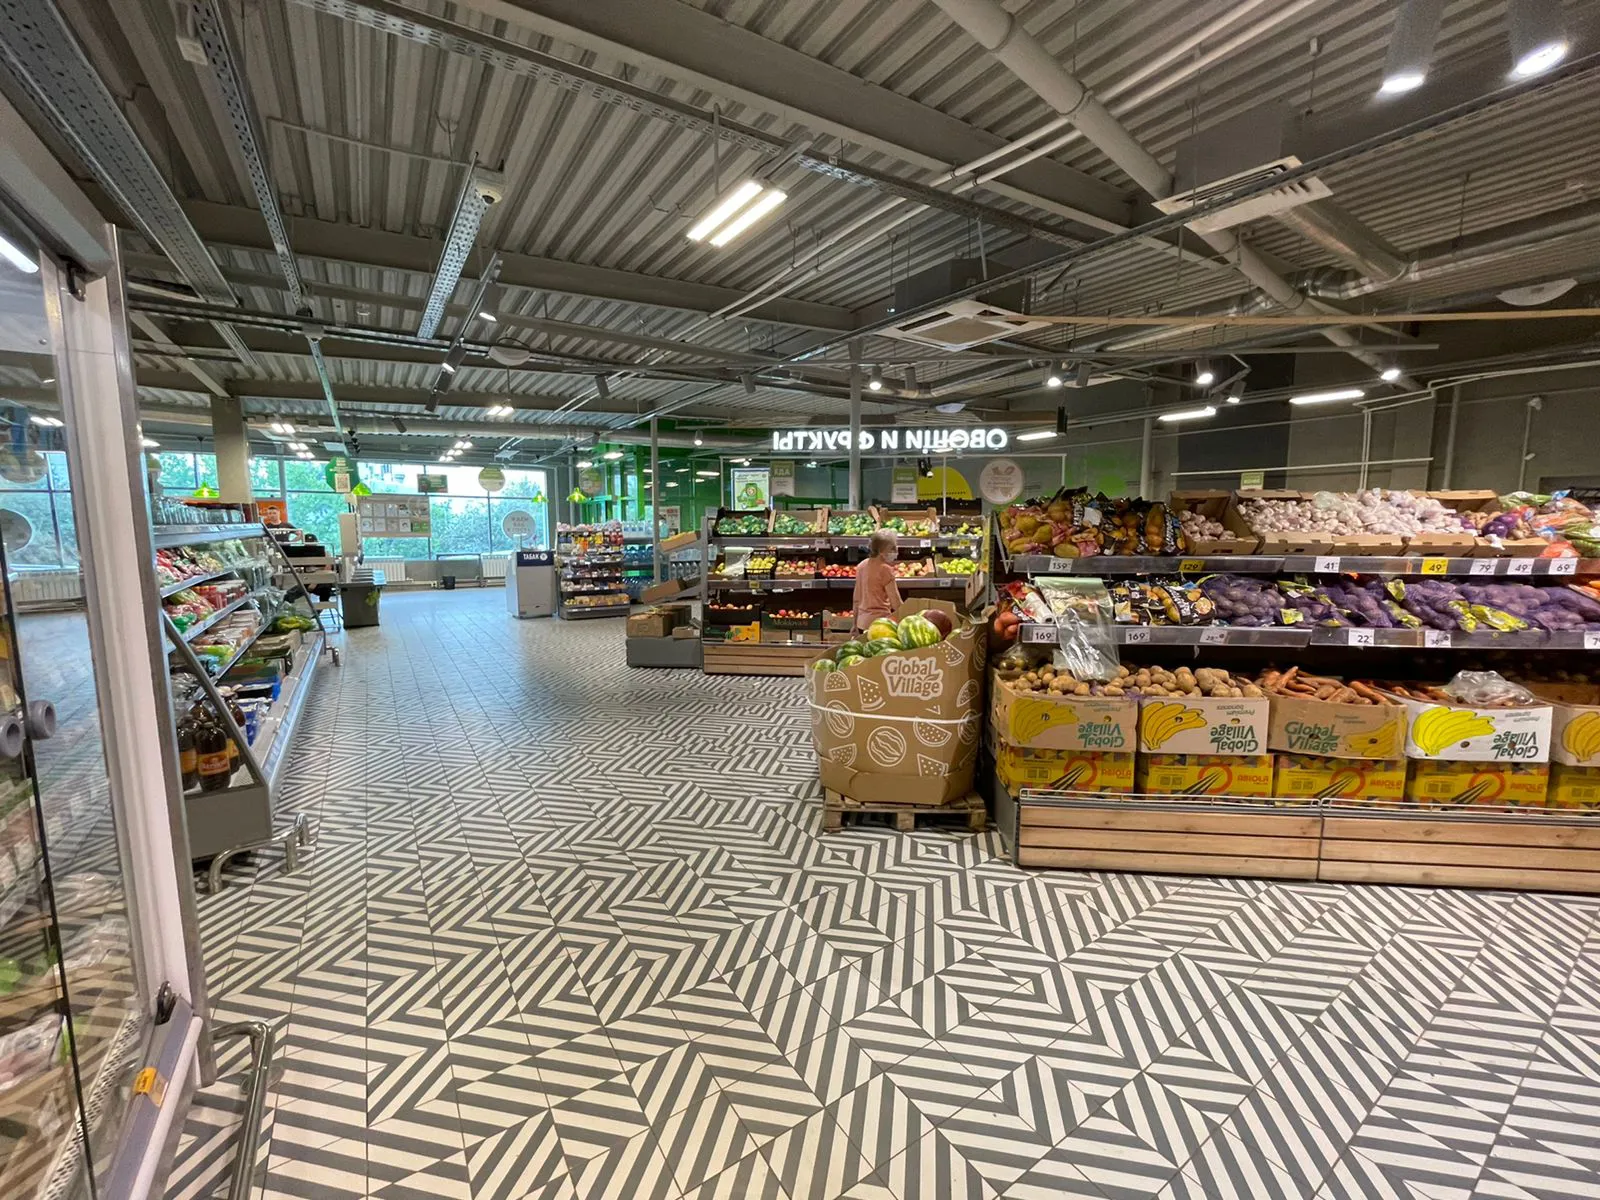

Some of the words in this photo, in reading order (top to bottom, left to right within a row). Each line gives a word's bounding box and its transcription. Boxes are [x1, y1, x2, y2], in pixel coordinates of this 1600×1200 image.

[1052, 562, 1068, 570] 159
[1323, 562, 1335, 570] 41
[1428, 564, 1442, 572] 49
[1479, 564, 1491, 573] 79
[1514, 564, 1528, 572] 49
[1556, 563, 1570, 572] 69
[1035, 632, 1051, 641] 169
[1128, 632, 1145, 641] 169
[1357, 634, 1370, 643] 22
[885, 659, 933, 675] Global
[888, 676, 940, 697] Village
[1078, 722, 1122, 736] Village
[1210, 724, 1255, 739] Village
[1284, 721, 1335, 737] Global
[1085, 733, 1125, 748] Global
[1216, 737, 1259, 753] Global
[1287, 735, 1338, 754] Village
[1493, 730, 1538, 746] Village
[1495, 743, 1539, 760] Global
